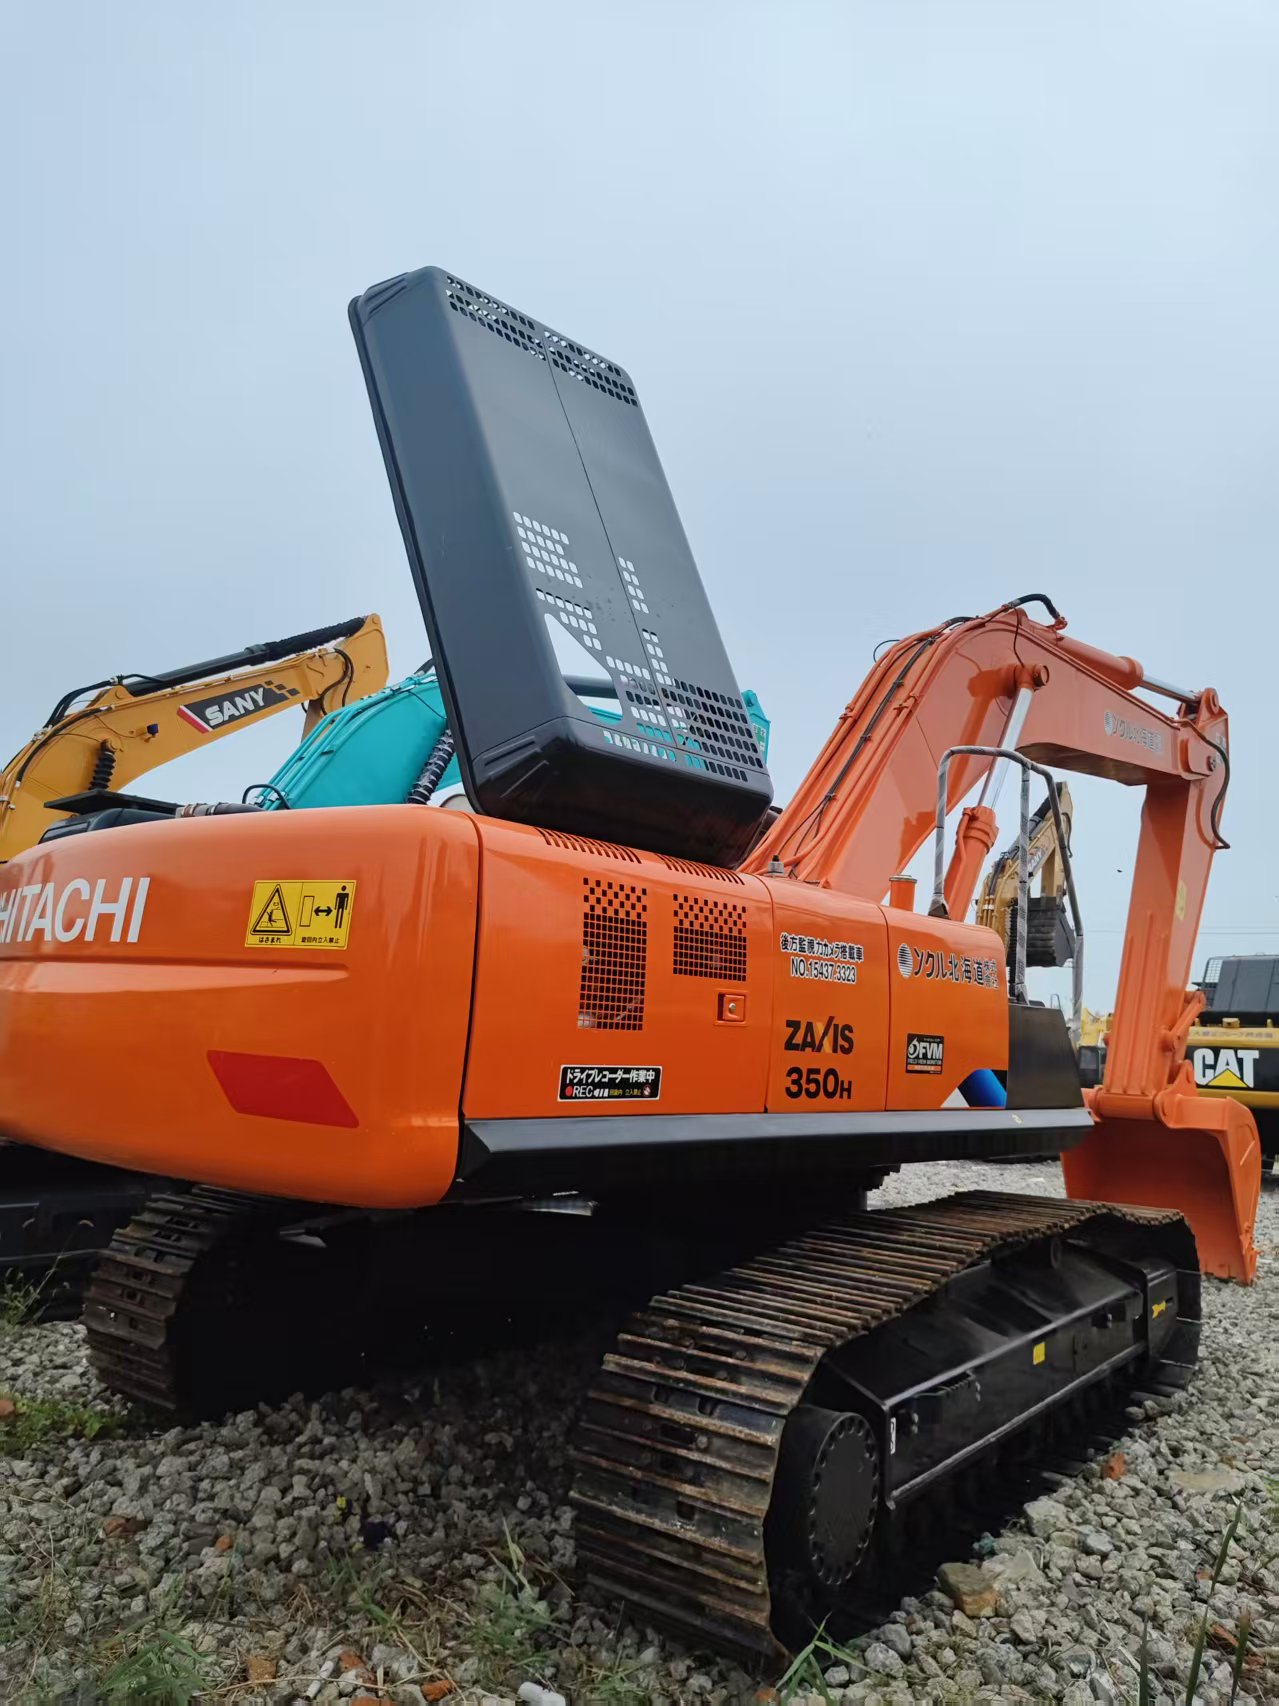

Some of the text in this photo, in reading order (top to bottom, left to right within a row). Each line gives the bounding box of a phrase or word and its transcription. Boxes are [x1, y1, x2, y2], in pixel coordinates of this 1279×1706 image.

[205, 687, 265, 727] SANY
[0, 877, 151, 944] HITACHI
[784, 1016, 854, 1055] ZAXIS
[919, 1041, 943, 1060] FVM
[785, 1066, 852, 1099] 350H
[1194, 1048, 1259, 1088] CAT
[573, 1086, 593, 1097] REC
